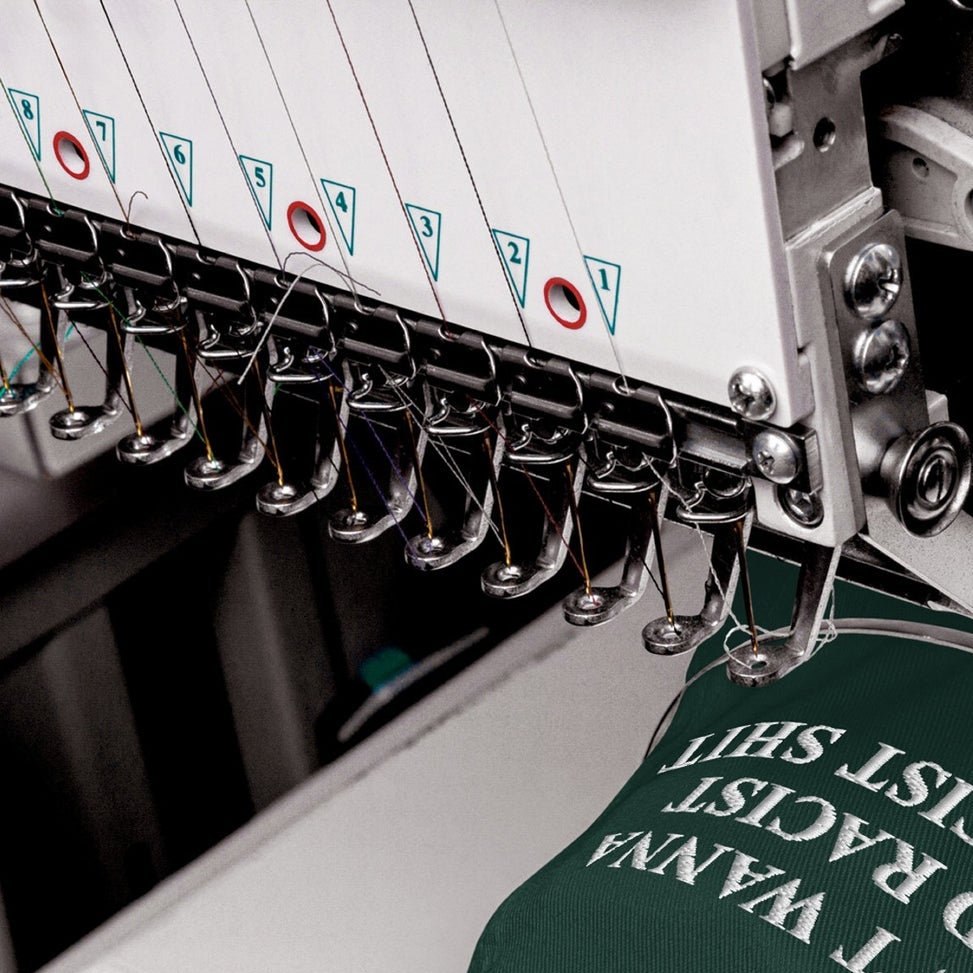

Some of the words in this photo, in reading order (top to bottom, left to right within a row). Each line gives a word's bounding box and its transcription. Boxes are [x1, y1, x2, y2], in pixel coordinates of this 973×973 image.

[21, 98, 35, 121] 8
[95, 120, 107, 142] 7
[173, 144, 187, 166] 6
[254, 165, 267, 189] 5
[334, 191, 349, 213] 4
[420, 215, 435, 238] 3
[507, 240, 523, 265] 2
[598, 267, 610, 292] 1
[657, 721, 847, 774] SHIT
[661, 776, 949, 905] RACIST
[585, 830, 826, 945] WANNA
